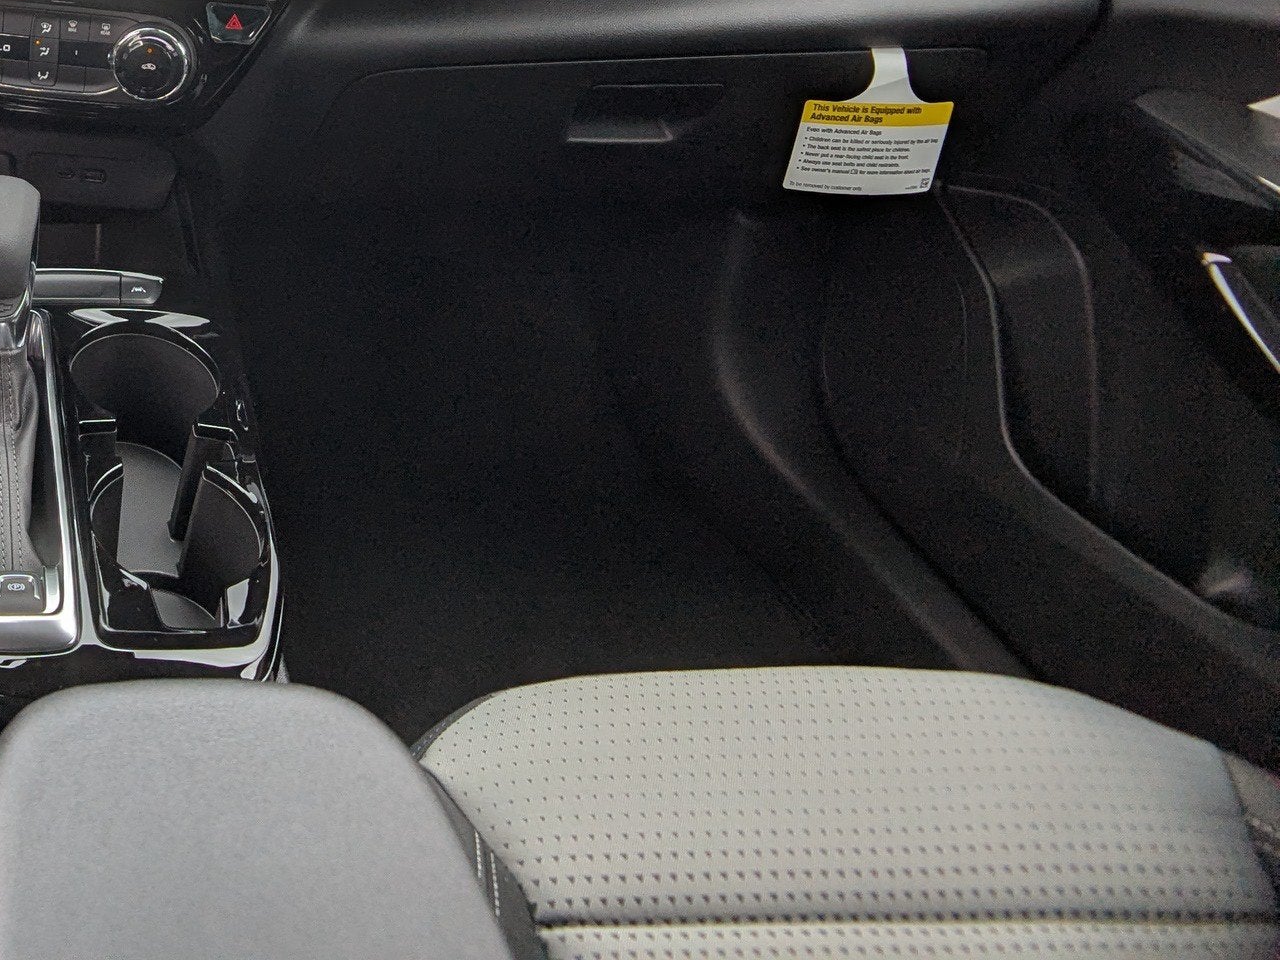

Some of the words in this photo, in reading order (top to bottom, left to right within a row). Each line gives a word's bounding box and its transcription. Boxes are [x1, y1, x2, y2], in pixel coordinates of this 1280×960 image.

[813, 103, 830, 111] This
[833, 105, 860, 113] Vehicle
[870, 106, 905, 116] Equipped
[907, 106, 922, 114] with
[810, 113, 850, 122] Advanced
[851, 114, 863, 122] Air
[865, 115, 883, 124] Bags
